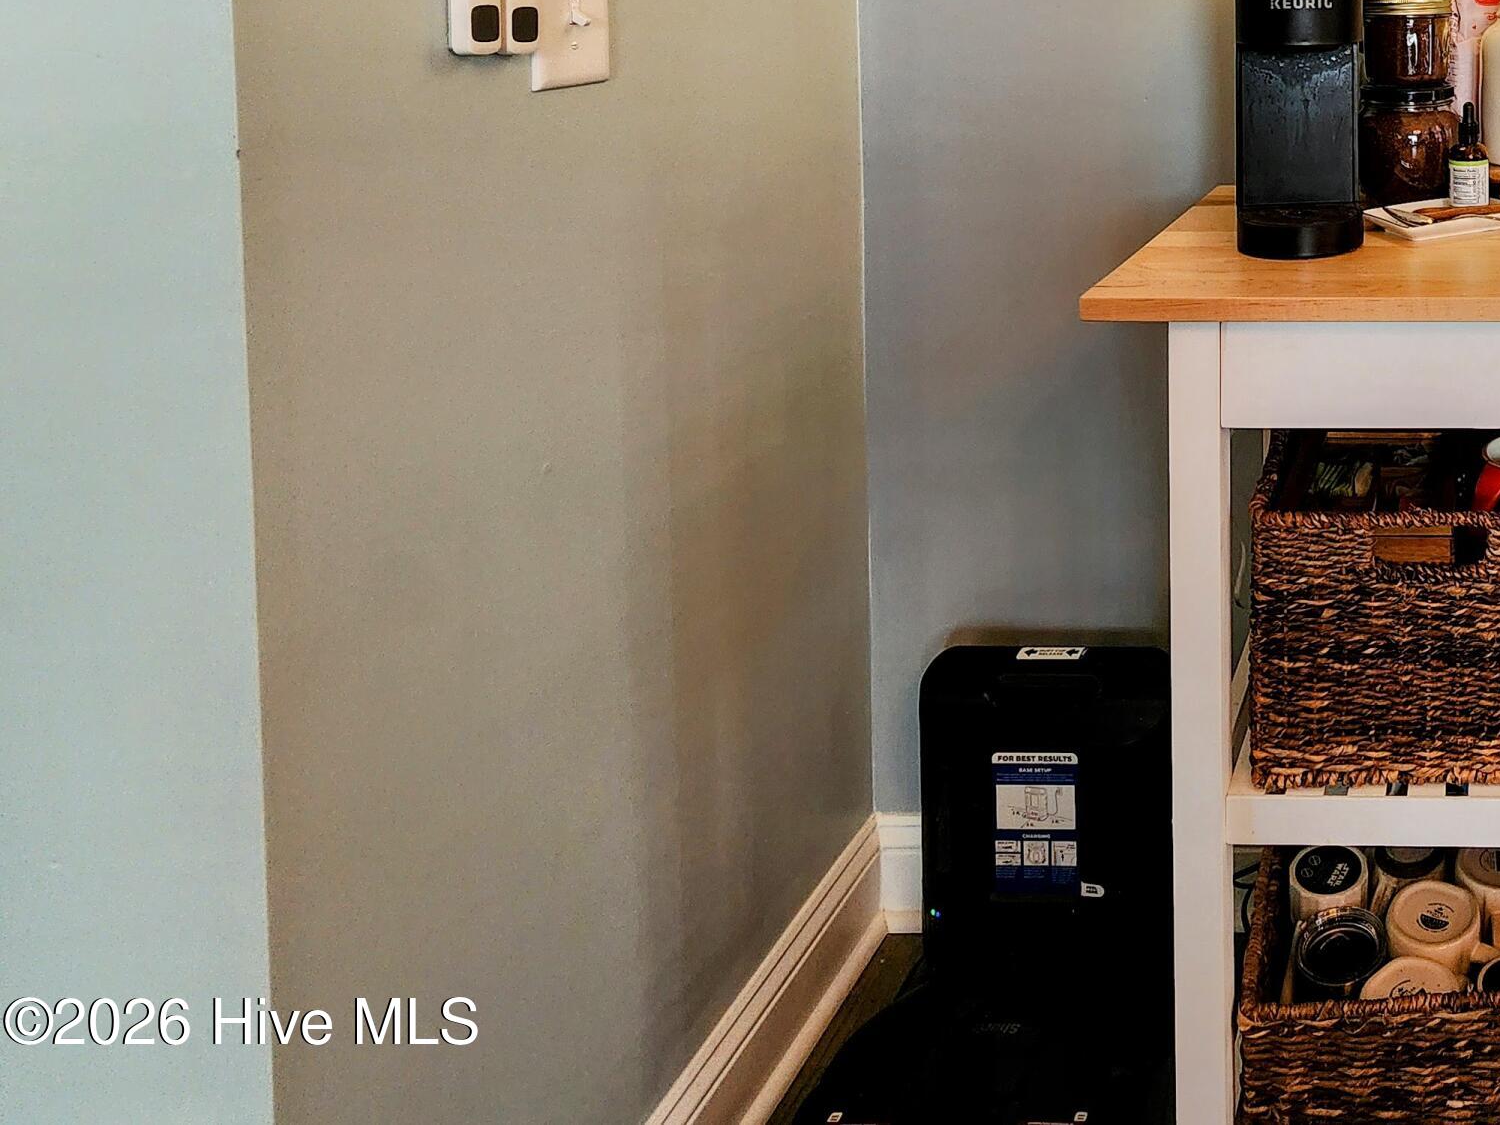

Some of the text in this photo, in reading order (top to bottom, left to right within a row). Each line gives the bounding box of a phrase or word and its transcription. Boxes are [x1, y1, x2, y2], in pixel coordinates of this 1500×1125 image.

[1015, 755, 1036, 763] BEST
[1037, 755, 1073, 763] RESULTS
[1326, 862, 1350, 887] STAR WARS
